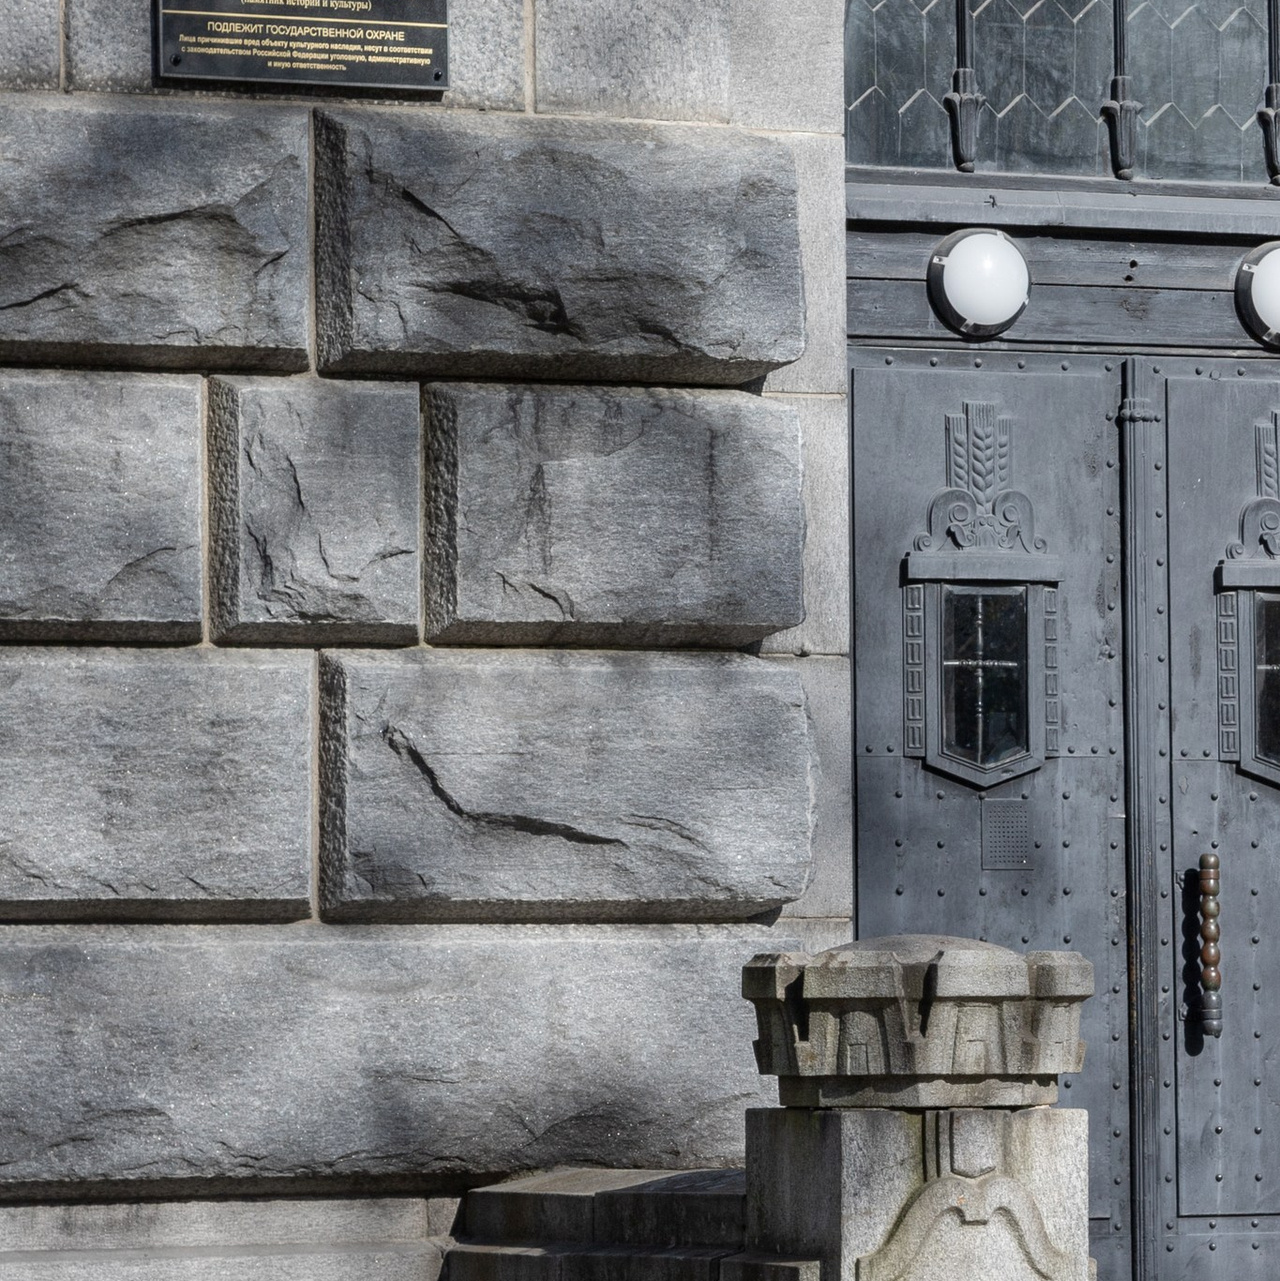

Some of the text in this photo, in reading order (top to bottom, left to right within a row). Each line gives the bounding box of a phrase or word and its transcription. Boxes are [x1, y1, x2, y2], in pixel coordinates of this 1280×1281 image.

[330, 0, 372, 11] культуры)
[207, 21, 405, 41] ПОДЛЕЖИТ ГОСУДАРСТВЕННОЙ ОХРАНЕ
[179, 34, 196, 43] Лица
[197, 36, 242, 45] причинившие
[244, 38, 260, 47] вред
[261, 38, 288, 48] объекту
[289, 41, 329, 50] культурного
[330, 43, 363, 52] наследия,
[364, 45, 382, 53] несут
[389, 46, 433, 55] соответствии
[186, 46, 252, 56] законодательством
[252, 48, 291, 58] Российской
[291, 50, 329, 60] Федерации
[329, 53, 367, 63] уголовную,
[368, 55, 431, 66] административную
[273, 61, 291, 69] иную
